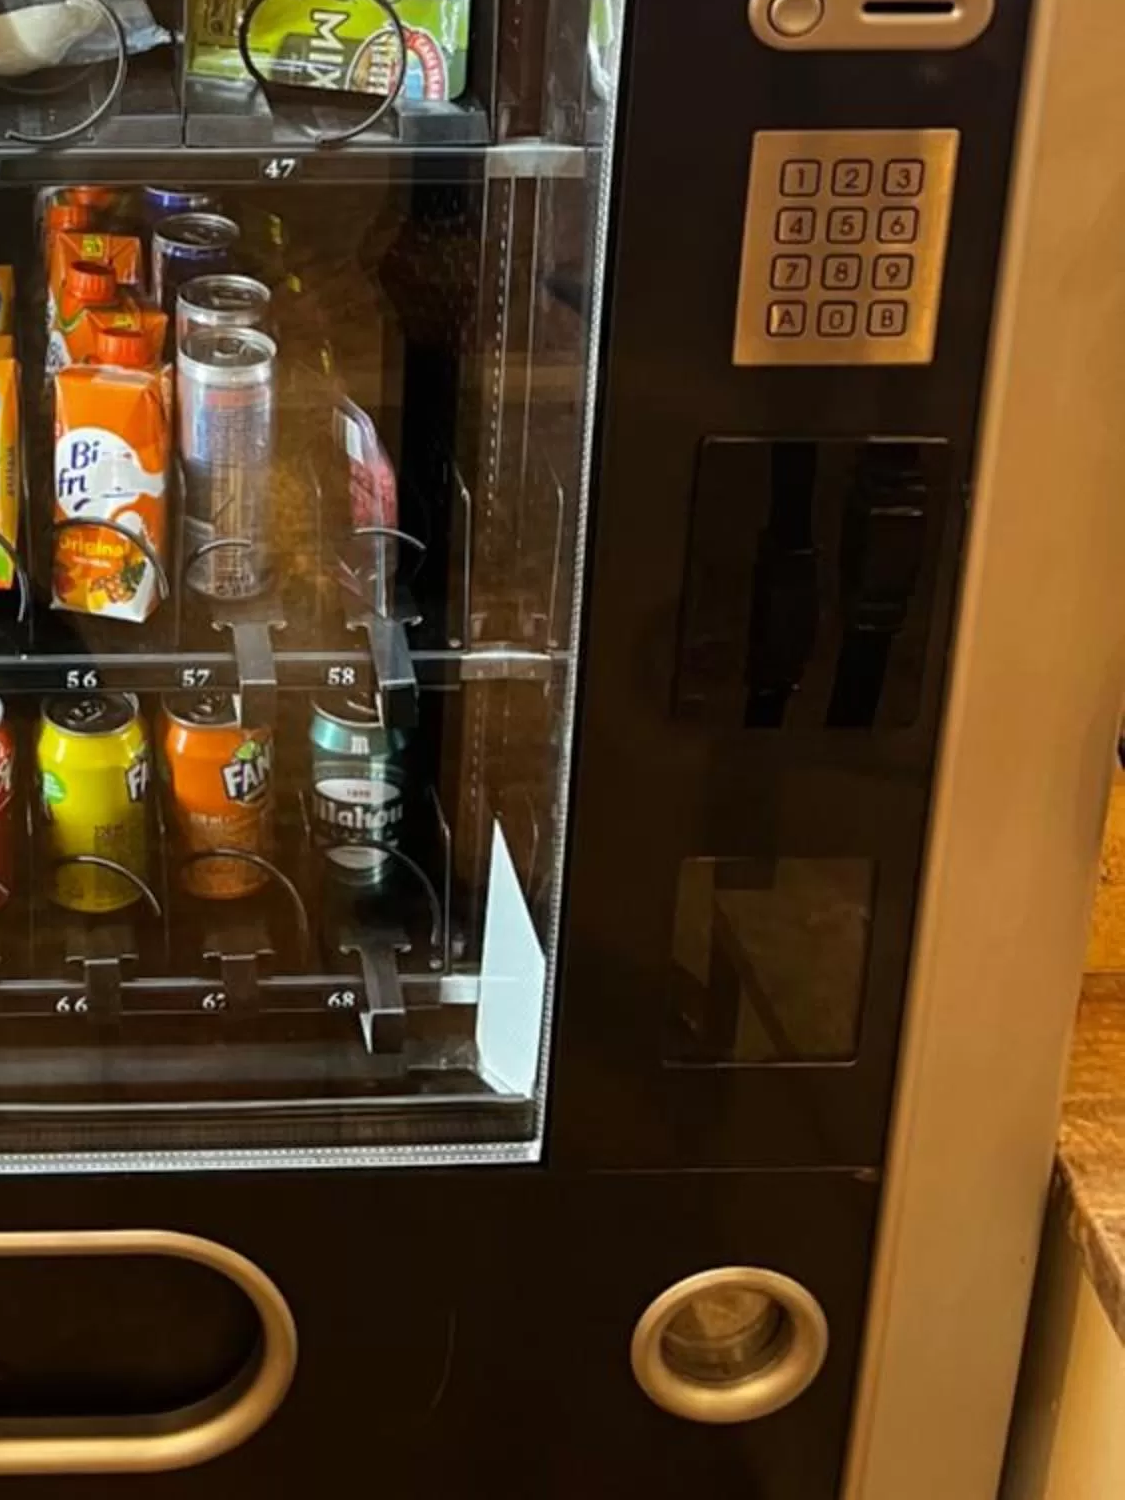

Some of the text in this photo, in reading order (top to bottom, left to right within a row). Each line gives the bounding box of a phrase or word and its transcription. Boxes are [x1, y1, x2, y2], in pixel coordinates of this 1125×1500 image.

[306, 10, 350, 90] MIX
[263, 159, 296, 180] 47
[844, 167, 860, 190] 2
[896, 168, 912, 190] 3
[789, 214, 906, 236] 4 5 6
[784, 262, 901, 283] 7 8 9
[777, 308, 796, 328] A
[70, 439, 101, 470] Bi
[65, 670, 98, 689] 56
[181, 669, 211, 689] 57
[326, 667, 356, 686] 58
[224, 752, 271, 797] FAN
[313, 795, 405, 831] Mahou
[55, 995, 89, 1014] 66
[327, 990, 356, 1008] 68
